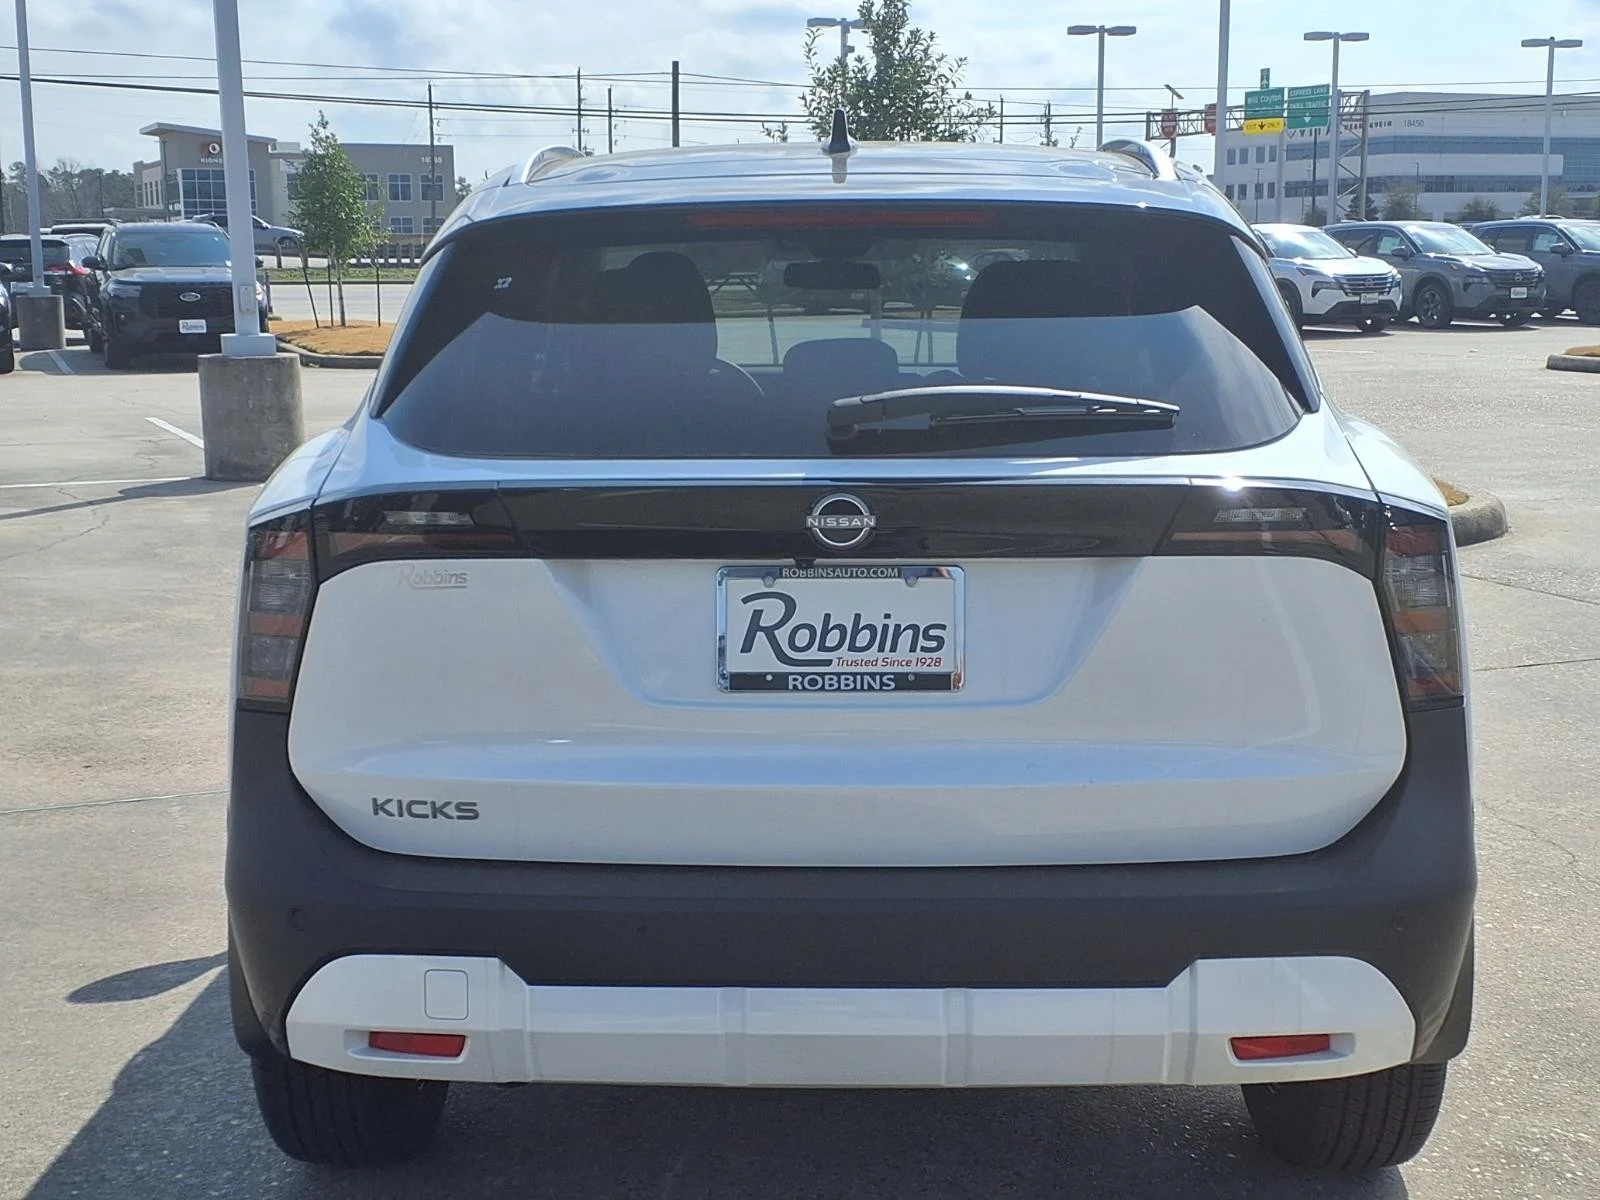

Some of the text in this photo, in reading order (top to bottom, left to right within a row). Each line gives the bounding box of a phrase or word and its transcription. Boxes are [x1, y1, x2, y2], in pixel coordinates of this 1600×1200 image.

[1267, 121, 1280, 129] ONLY
[1403, 119, 1425, 128] 18450
[808, 516, 875, 527] NISSAN
[399, 563, 468, 590] Robbins
[782, 567, 899, 579] ROBBINSAUTO.COM
[740, 591, 947, 668] Robbins
[835, 656, 942, 668] Trusted Since 1928
[788, 674, 896, 691] ROBBINS
[371, 796, 480, 821] KICKS
